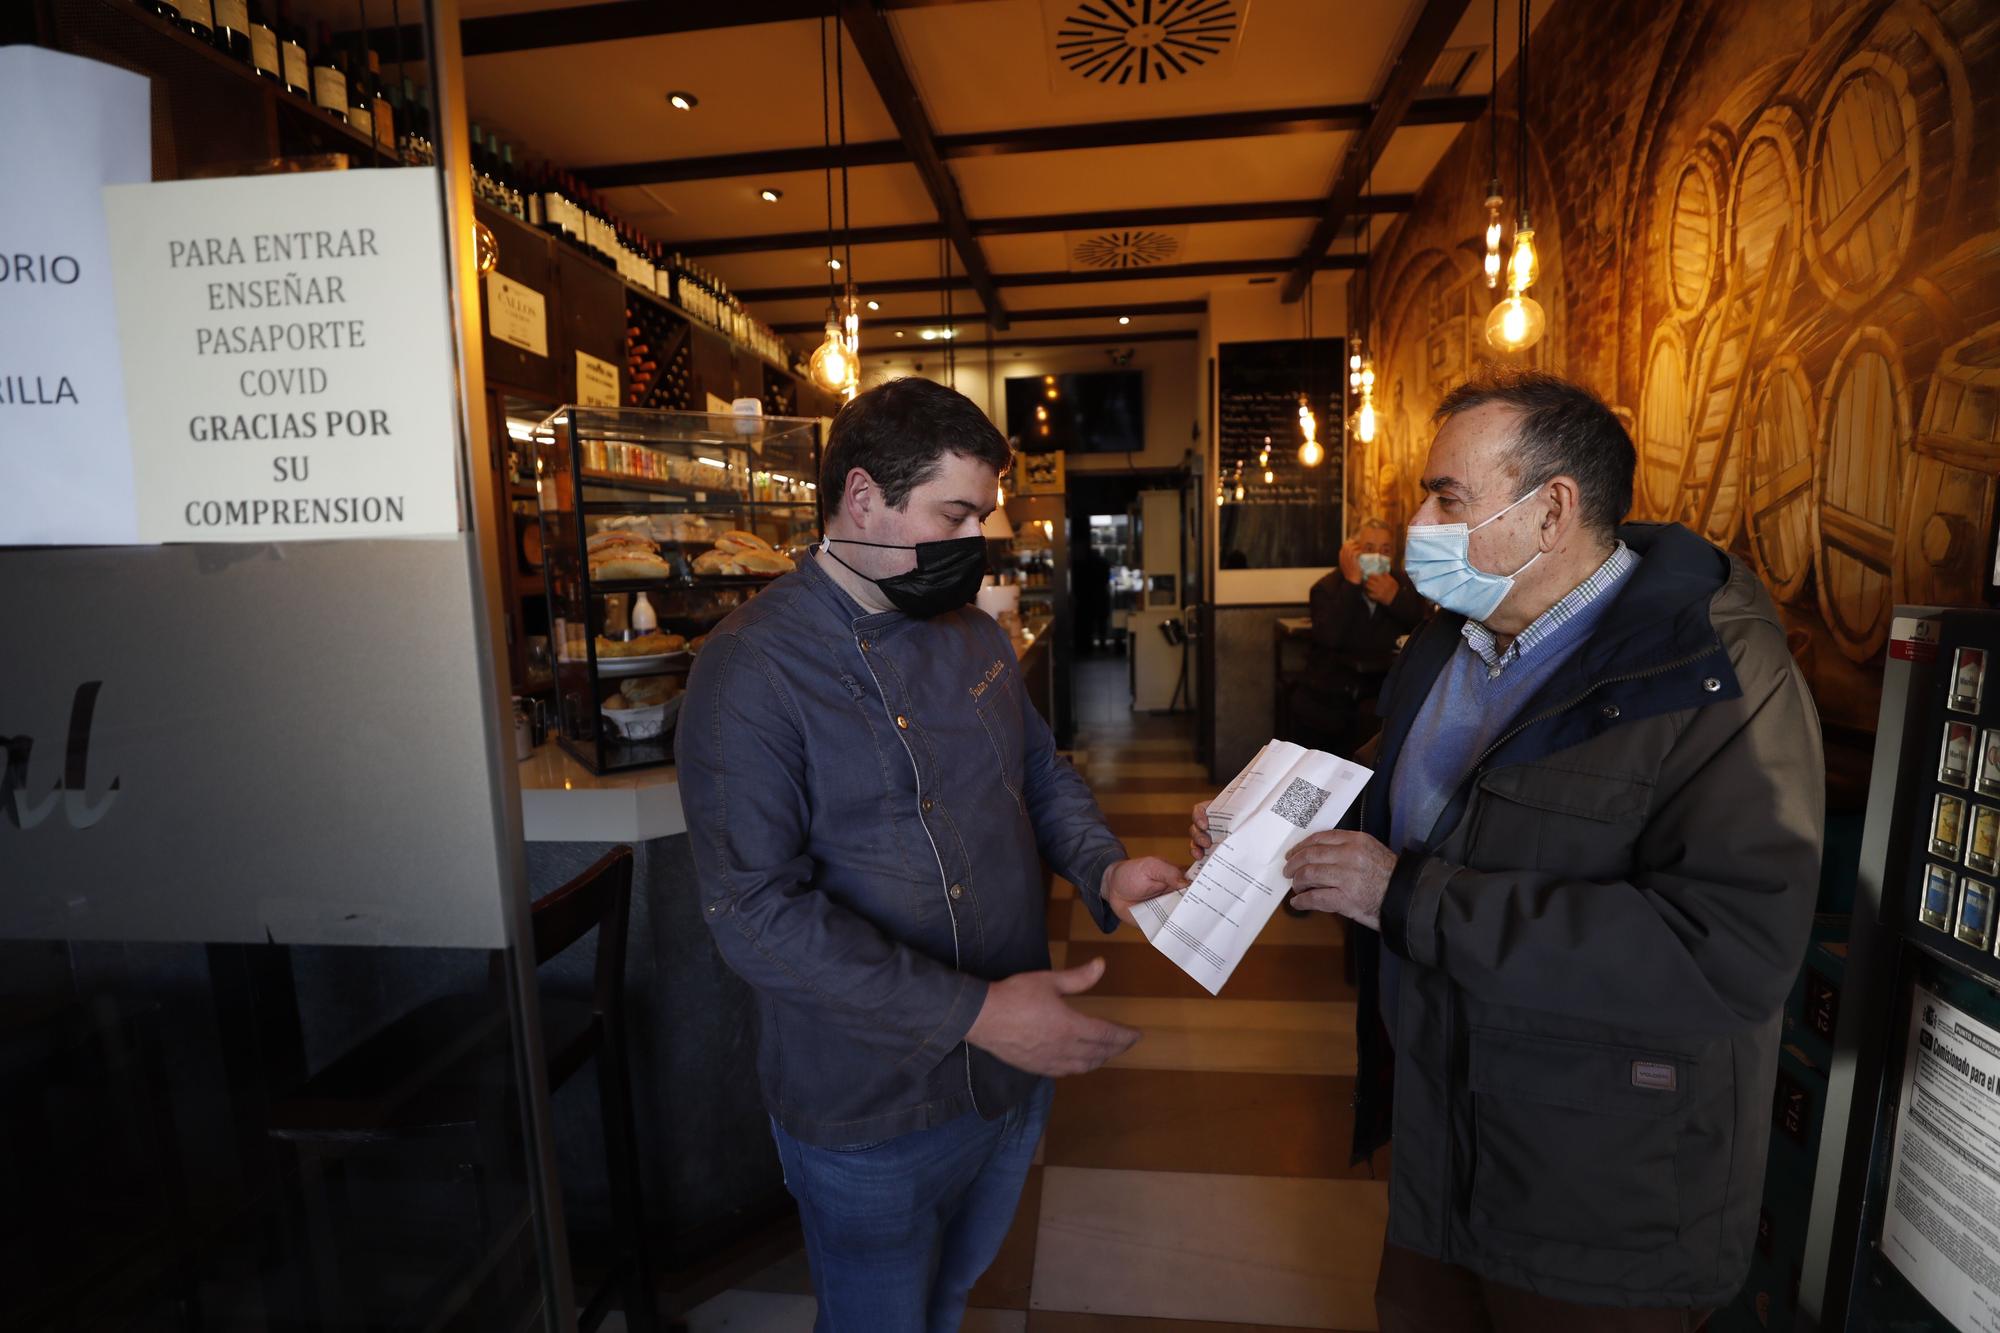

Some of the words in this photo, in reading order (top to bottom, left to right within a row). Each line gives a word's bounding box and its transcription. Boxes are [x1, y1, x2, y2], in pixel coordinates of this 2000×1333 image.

[168, 236, 247, 268] PARA
[254, 228, 379, 263] ENTRAR
[208, 272, 346, 311] ENSEÑAR
[196, 320, 366, 355] PASAPORTE
[240, 367, 328, 398] COVID
[189, 411, 318, 442] GRACIAS
[325, 409, 392, 437] POR
[272, 455, 310, 482] SU
[185, 495, 405, 527] COMPRENSION
[1933, 1037, 1970, 1077] Comisionado
[1970, 1065, 1986, 1087] para
[1987, 1074, 1996, 1093] el
